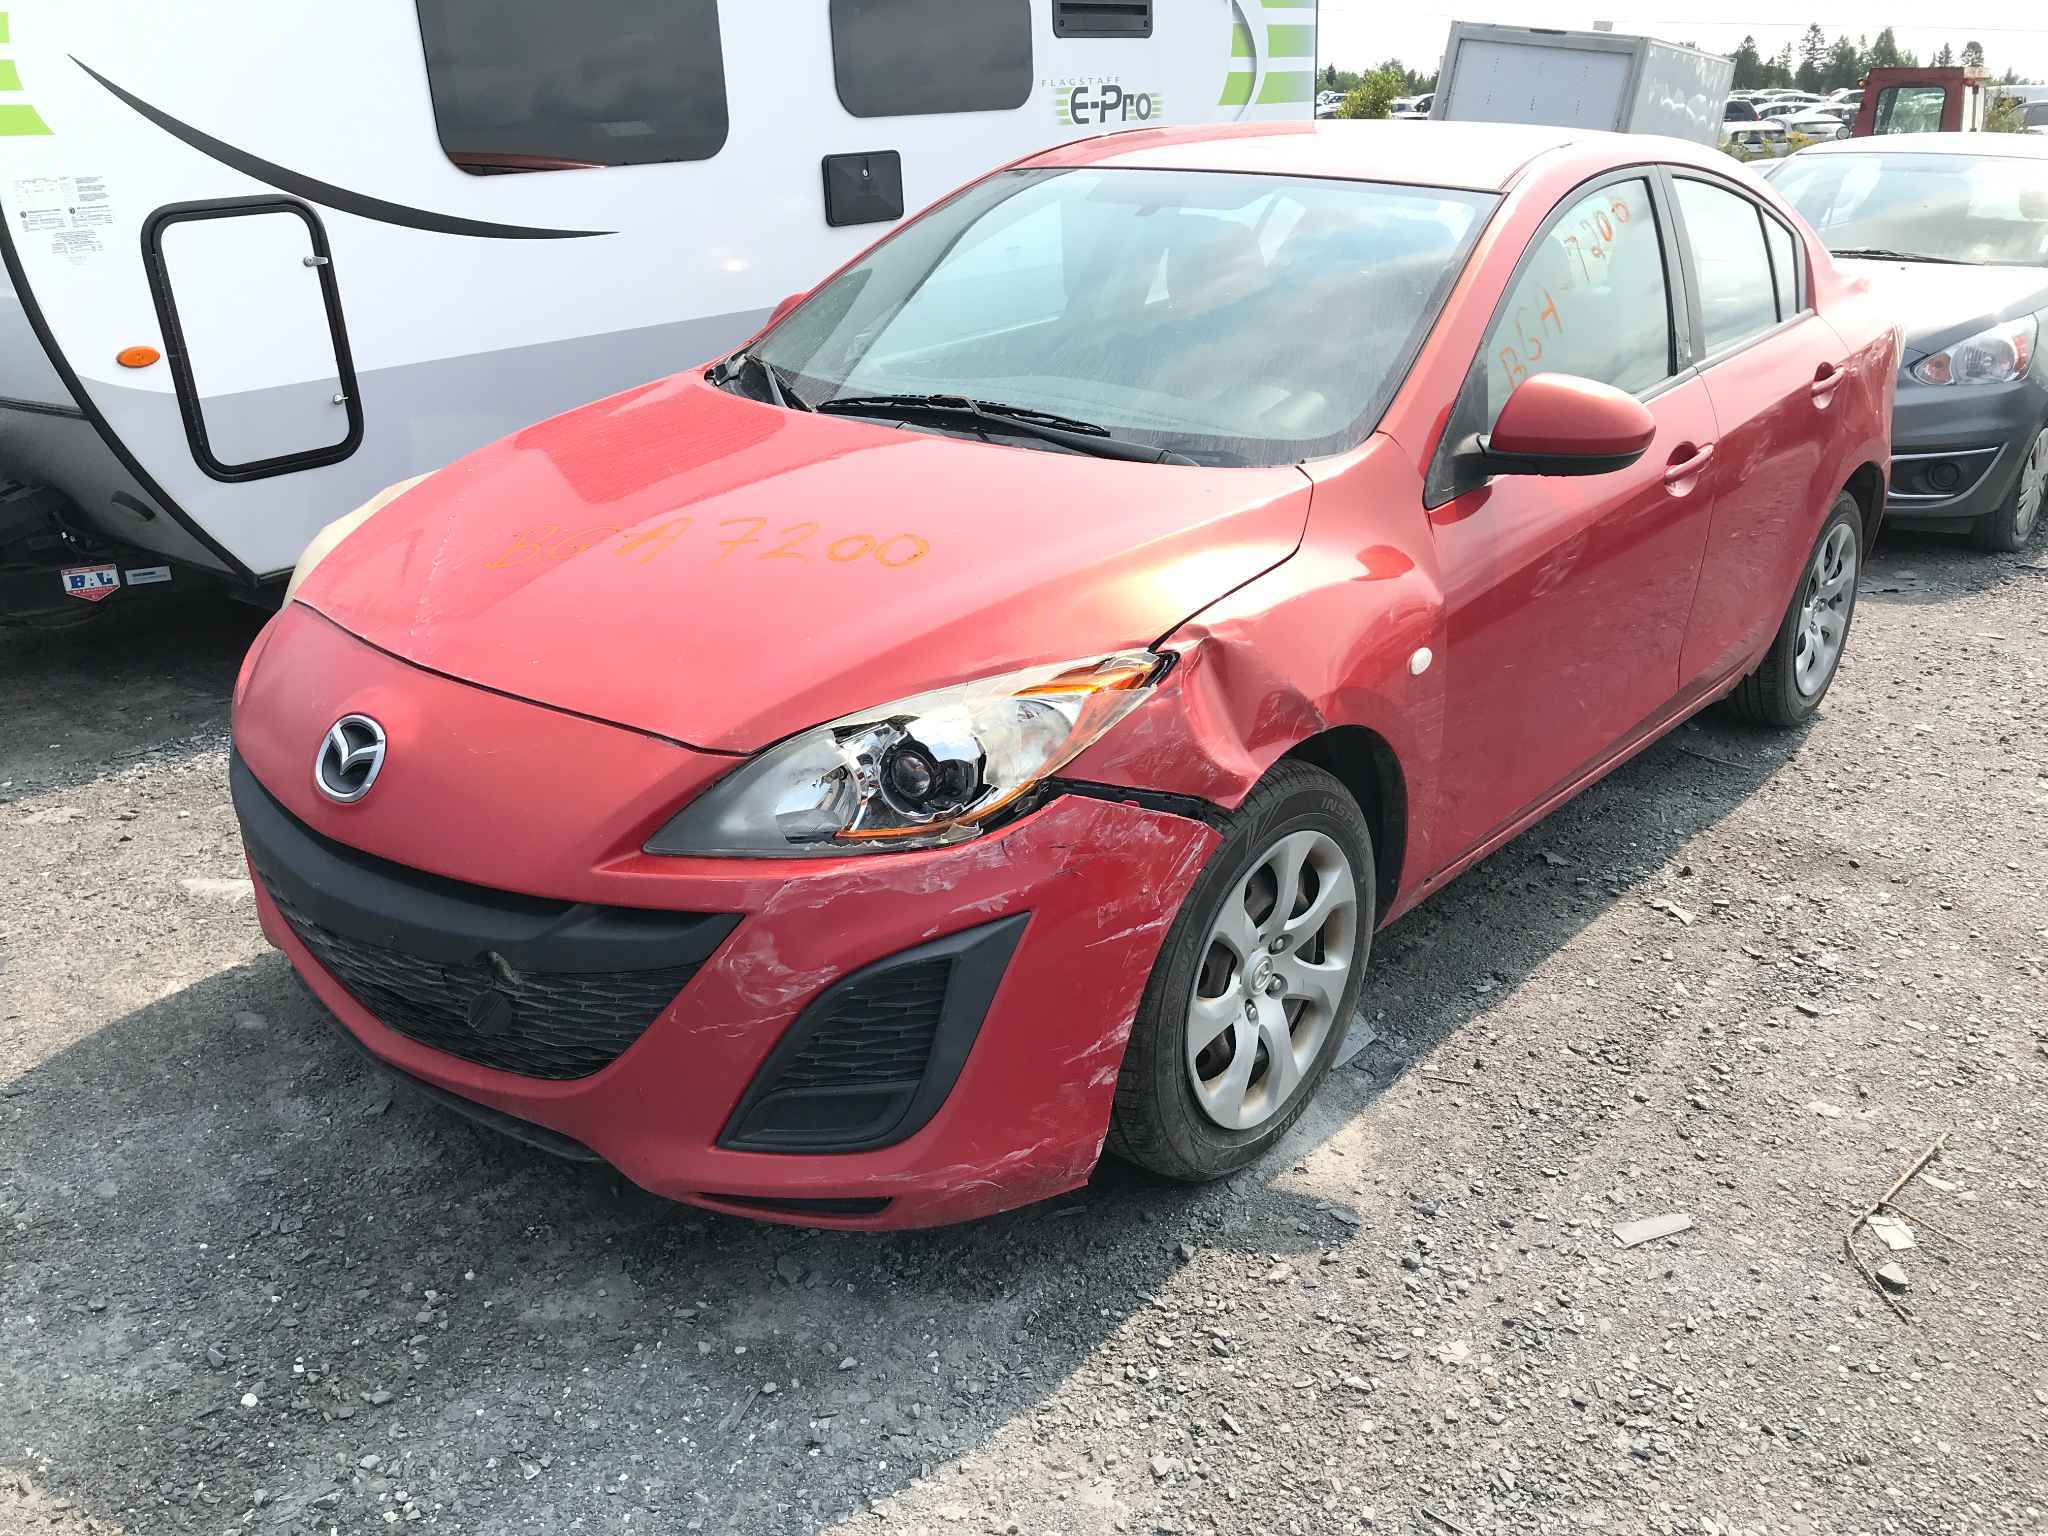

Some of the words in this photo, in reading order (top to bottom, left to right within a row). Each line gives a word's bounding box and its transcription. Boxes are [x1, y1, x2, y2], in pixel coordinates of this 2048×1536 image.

[1041, 76, 1121, 87] FLAGSTAFF
[1070, 84, 1152, 124] E-Pro
[711, 516, 930, 568] 7200
